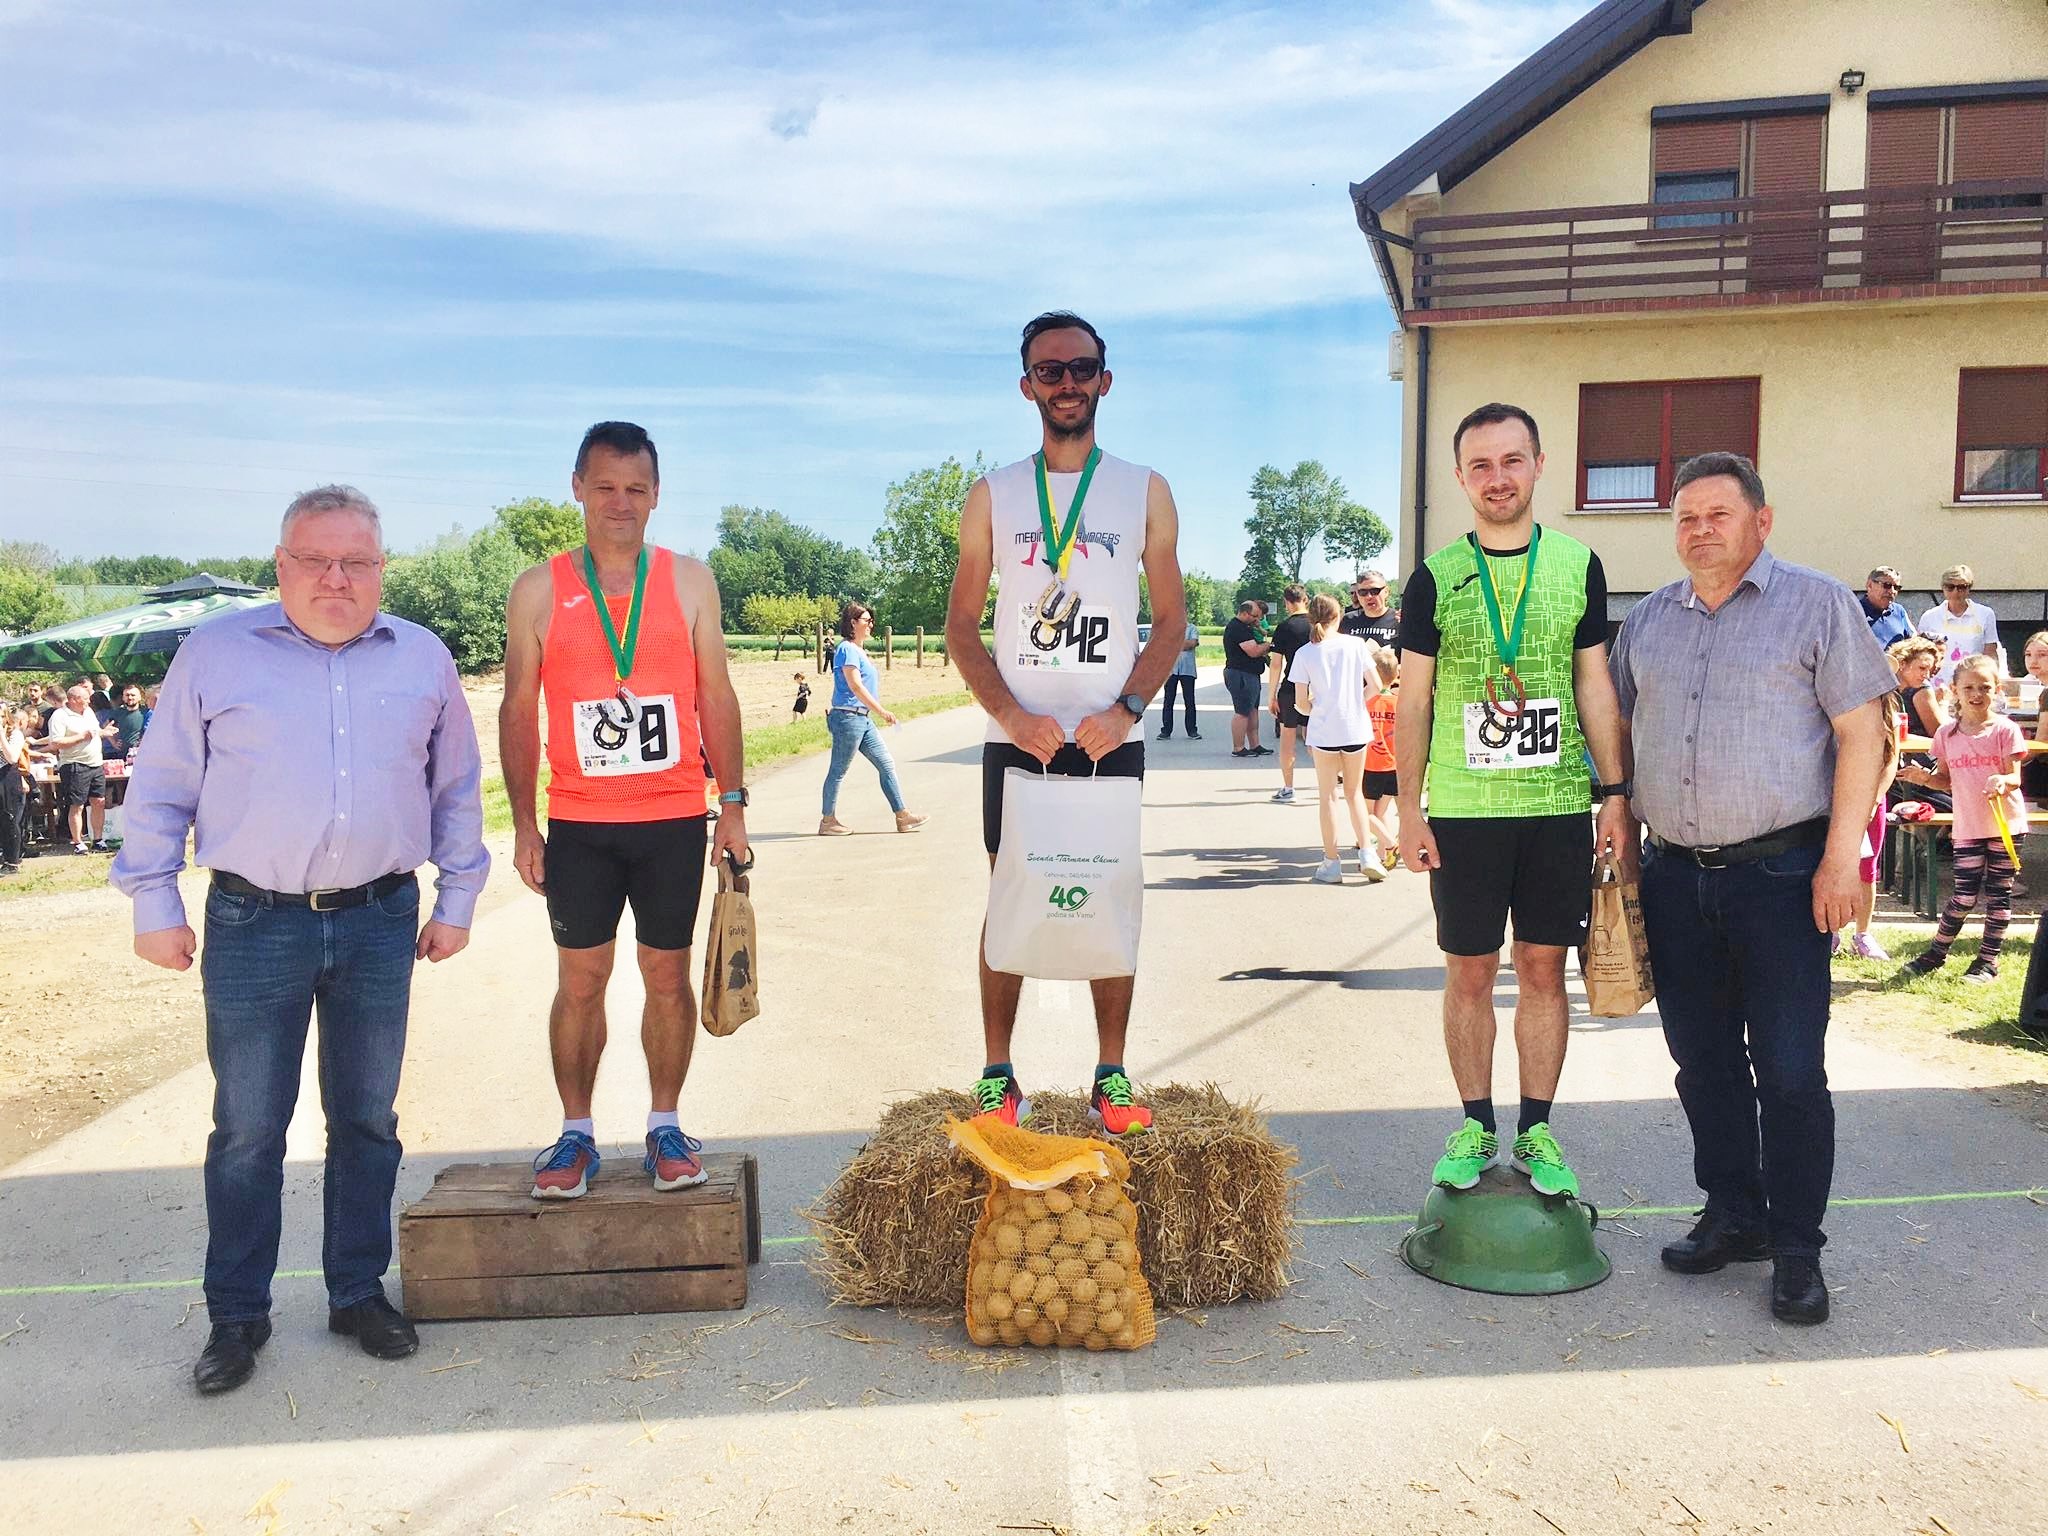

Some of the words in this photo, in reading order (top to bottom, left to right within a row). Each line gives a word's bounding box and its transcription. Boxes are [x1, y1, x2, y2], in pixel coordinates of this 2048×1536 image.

[1066, 616, 1109, 663] 42
[638, 704, 668, 762] 9
[1516, 707, 1559, 756] 35
[1949, 753, 2001, 769] adidas
[1092, 854, 1120, 864] Chemie
[1048, 885, 1088, 909] 40
